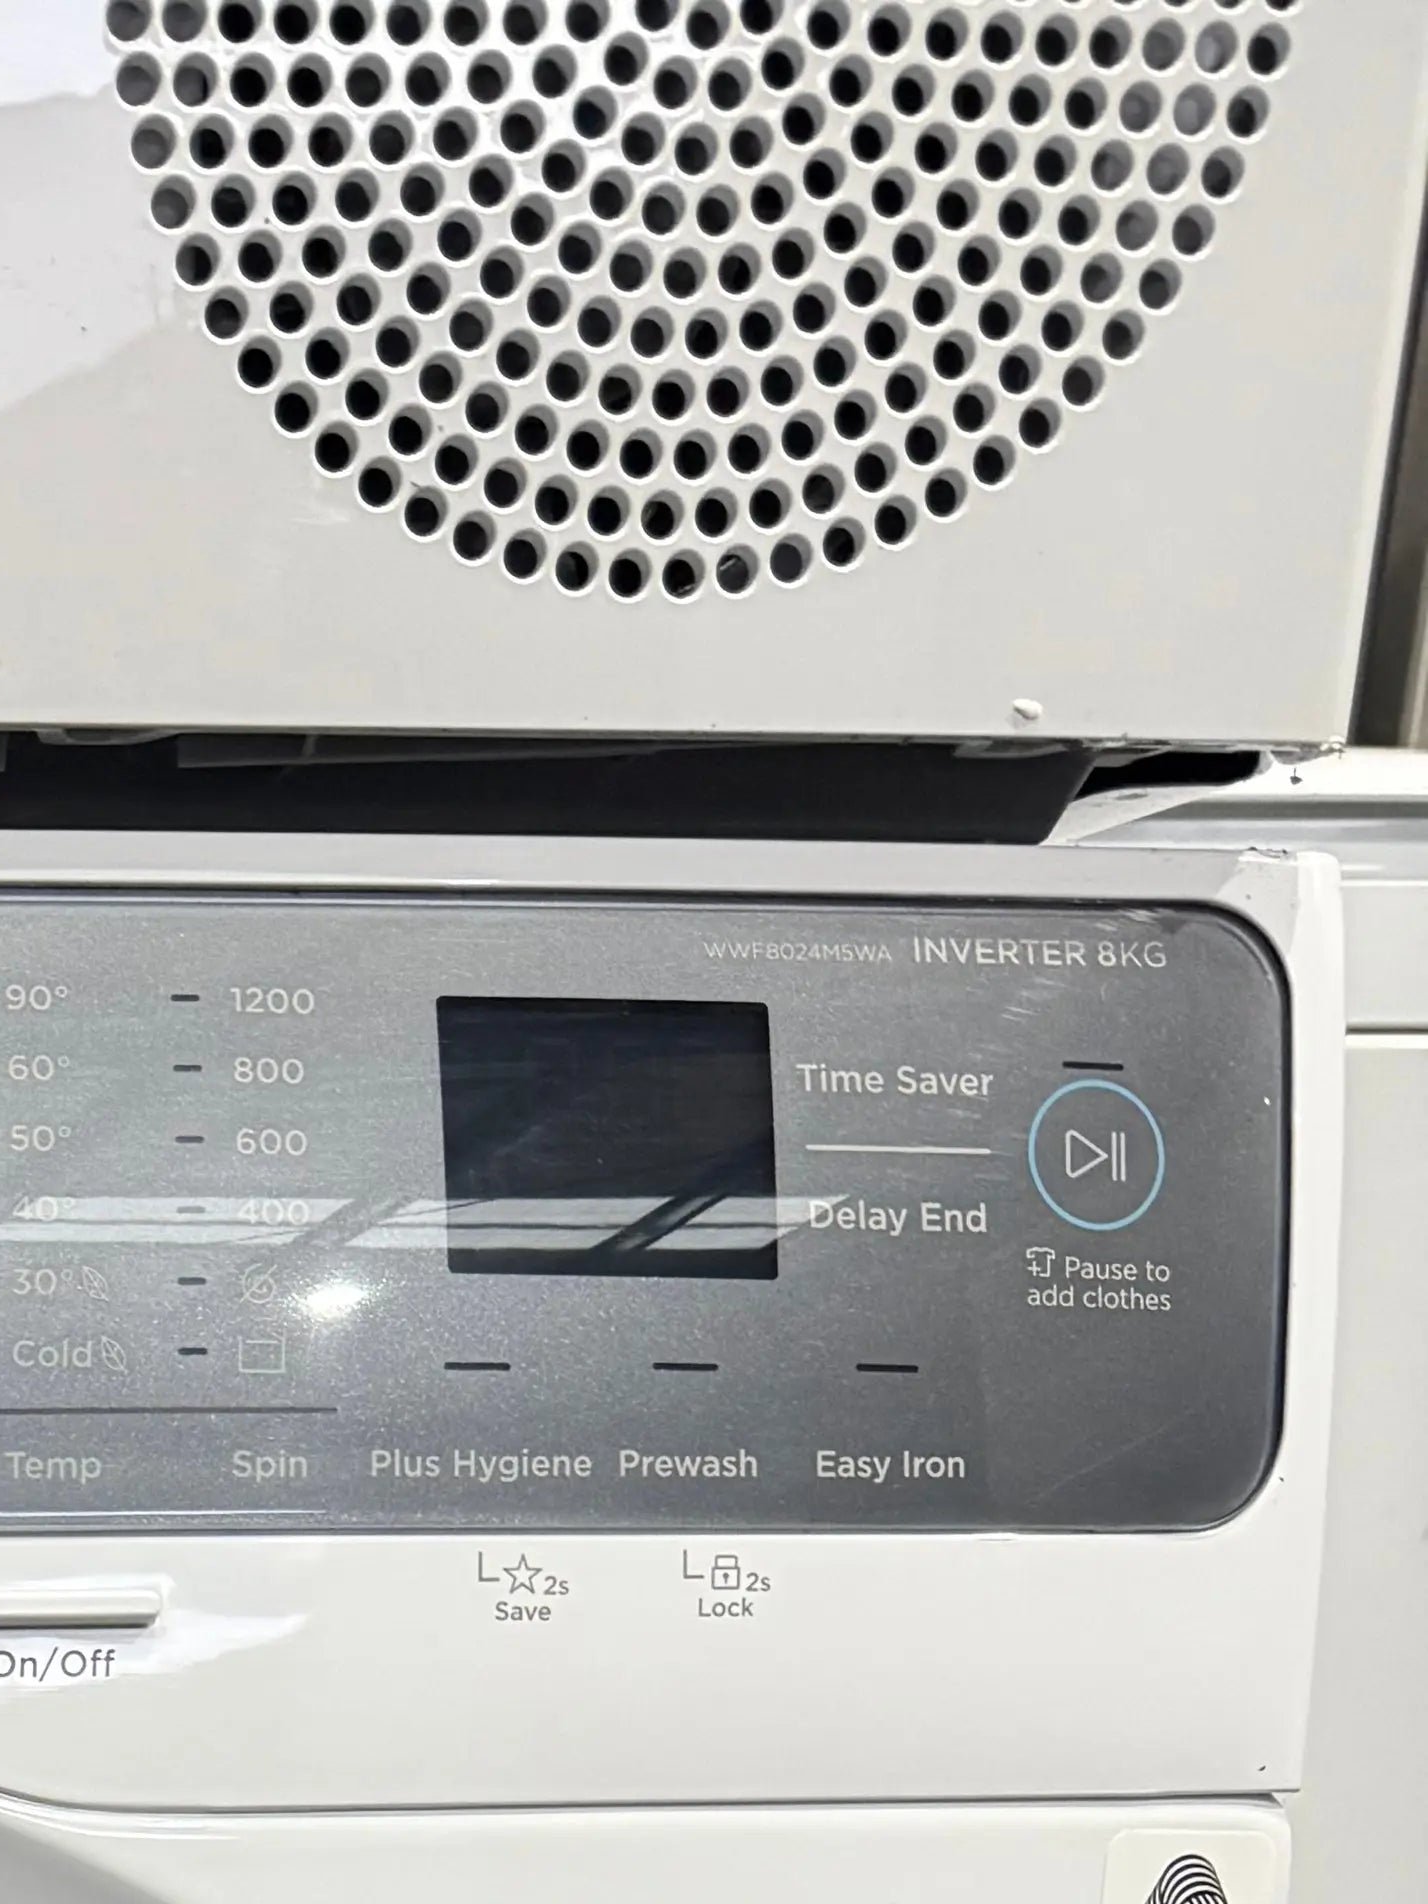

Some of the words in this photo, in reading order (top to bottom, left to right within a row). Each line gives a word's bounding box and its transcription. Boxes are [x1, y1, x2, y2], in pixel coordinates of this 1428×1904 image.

[913, 936, 1087, 967] INVERTER
[1097, 941, 1167, 968] 8KG
[4, 984, 69, 1012] 90°
[231, 987, 314, 1014] 1200
[8, 1054, 71, 1081] 60°
[233, 1057, 305, 1084] 800
[795, 1062, 885, 1095] Time
[896, 1065, 993, 1097] Saver
[10, 1125, 72, 1152] 50°
[235, 1130, 307, 1155] 600
[12, 1196, 76, 1223] 40°
[237, 1198, 309, 1224] 400
[808, 1202, 907, 1237] Delay
[921, 1203, 988, 1235] End
[12, 1267, 74, 1296] 30°
[1063, 1256, 1140, 1282] Pause
[1145, 1259, 1171, 1282] to
[1027, 1284, 1077, 1307] add
[1083, 1286, 1172, 1312] clothes
[12, 1340, 93, 1368] Cold
[5, 1451, 103, 1486] Temp
[232, 1449, 308, 1486] Spin
[370, 1450, 440, 1479] Plus
[452, 1450, 592, 1484] Hygiene
[618, 1450, 759, 1479] Prewash
[816, 1450, 892, 1484] Easy
[902, 1450, 966, 1479] Iron
[544, 1575, 570, 1597] 2s
[745, 1572, 771, 1594] 2s
[494, 1602, 552, 1623] Save
[697, 1596, 754, 1618] Lock
